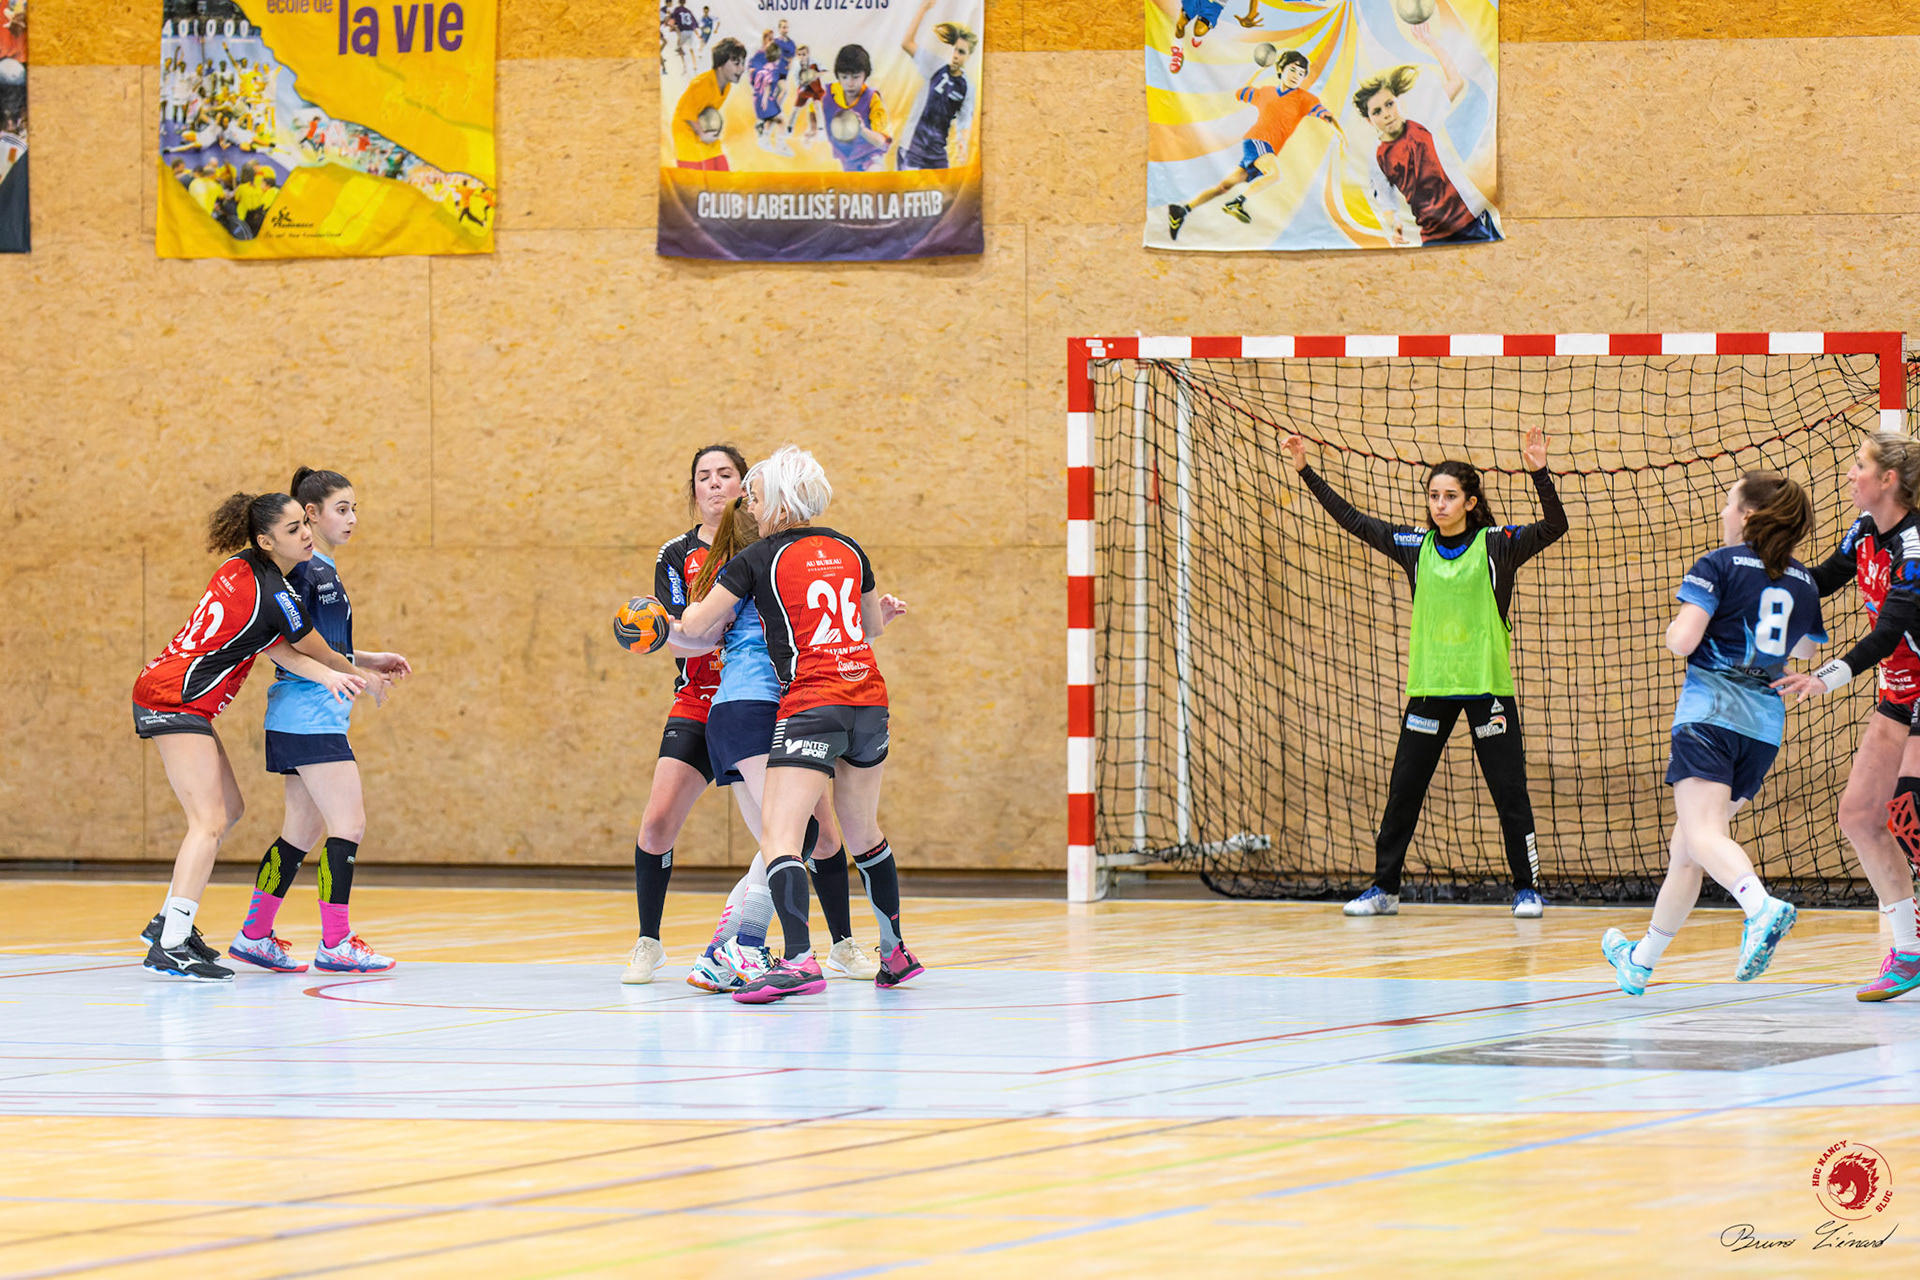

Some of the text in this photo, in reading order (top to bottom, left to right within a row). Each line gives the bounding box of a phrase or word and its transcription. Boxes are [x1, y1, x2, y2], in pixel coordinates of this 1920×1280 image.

[338, 0, 464, 57] la vie
[697, 188, 943, 220] CLUB LABELLISÉ PAR LA FFHB
[806, 577, 864, 647] 26
[1755, 586, 1795, 657] 8
[801, 748, 828, 760] SPORT
[802, 740, 829, 752] INTER
